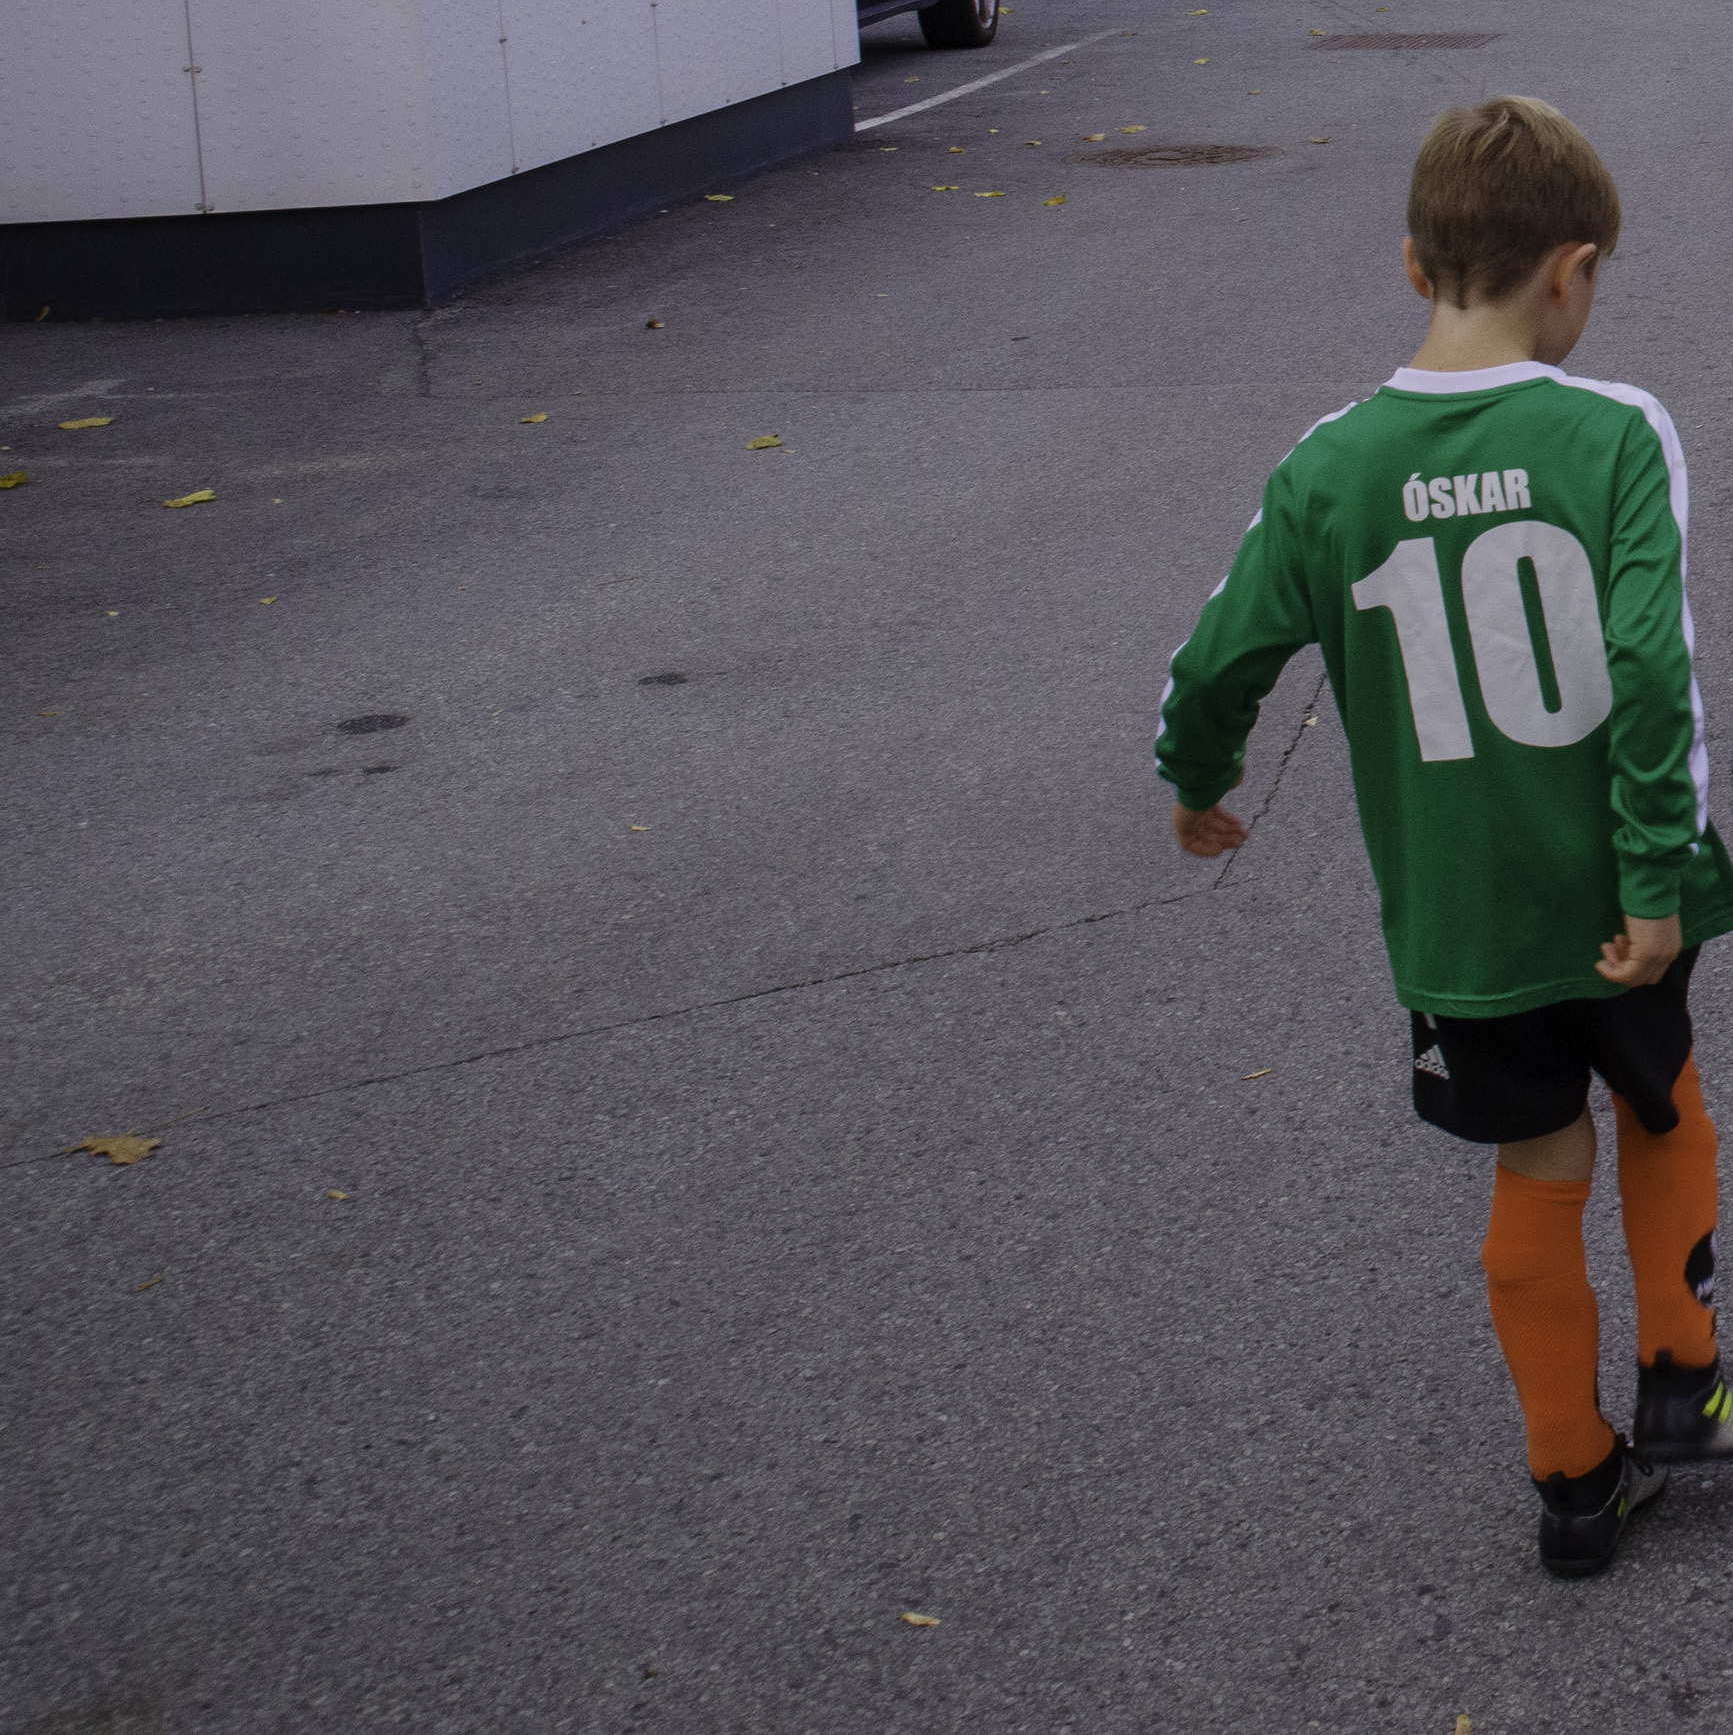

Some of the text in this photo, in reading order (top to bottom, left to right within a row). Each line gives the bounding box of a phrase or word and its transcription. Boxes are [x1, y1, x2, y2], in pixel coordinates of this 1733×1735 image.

[1402, 468, 1532, 522] ÓSKAR
[1351, 520, 1613, 762] 10
[1415, 1059, 1450, 1080] adidas
